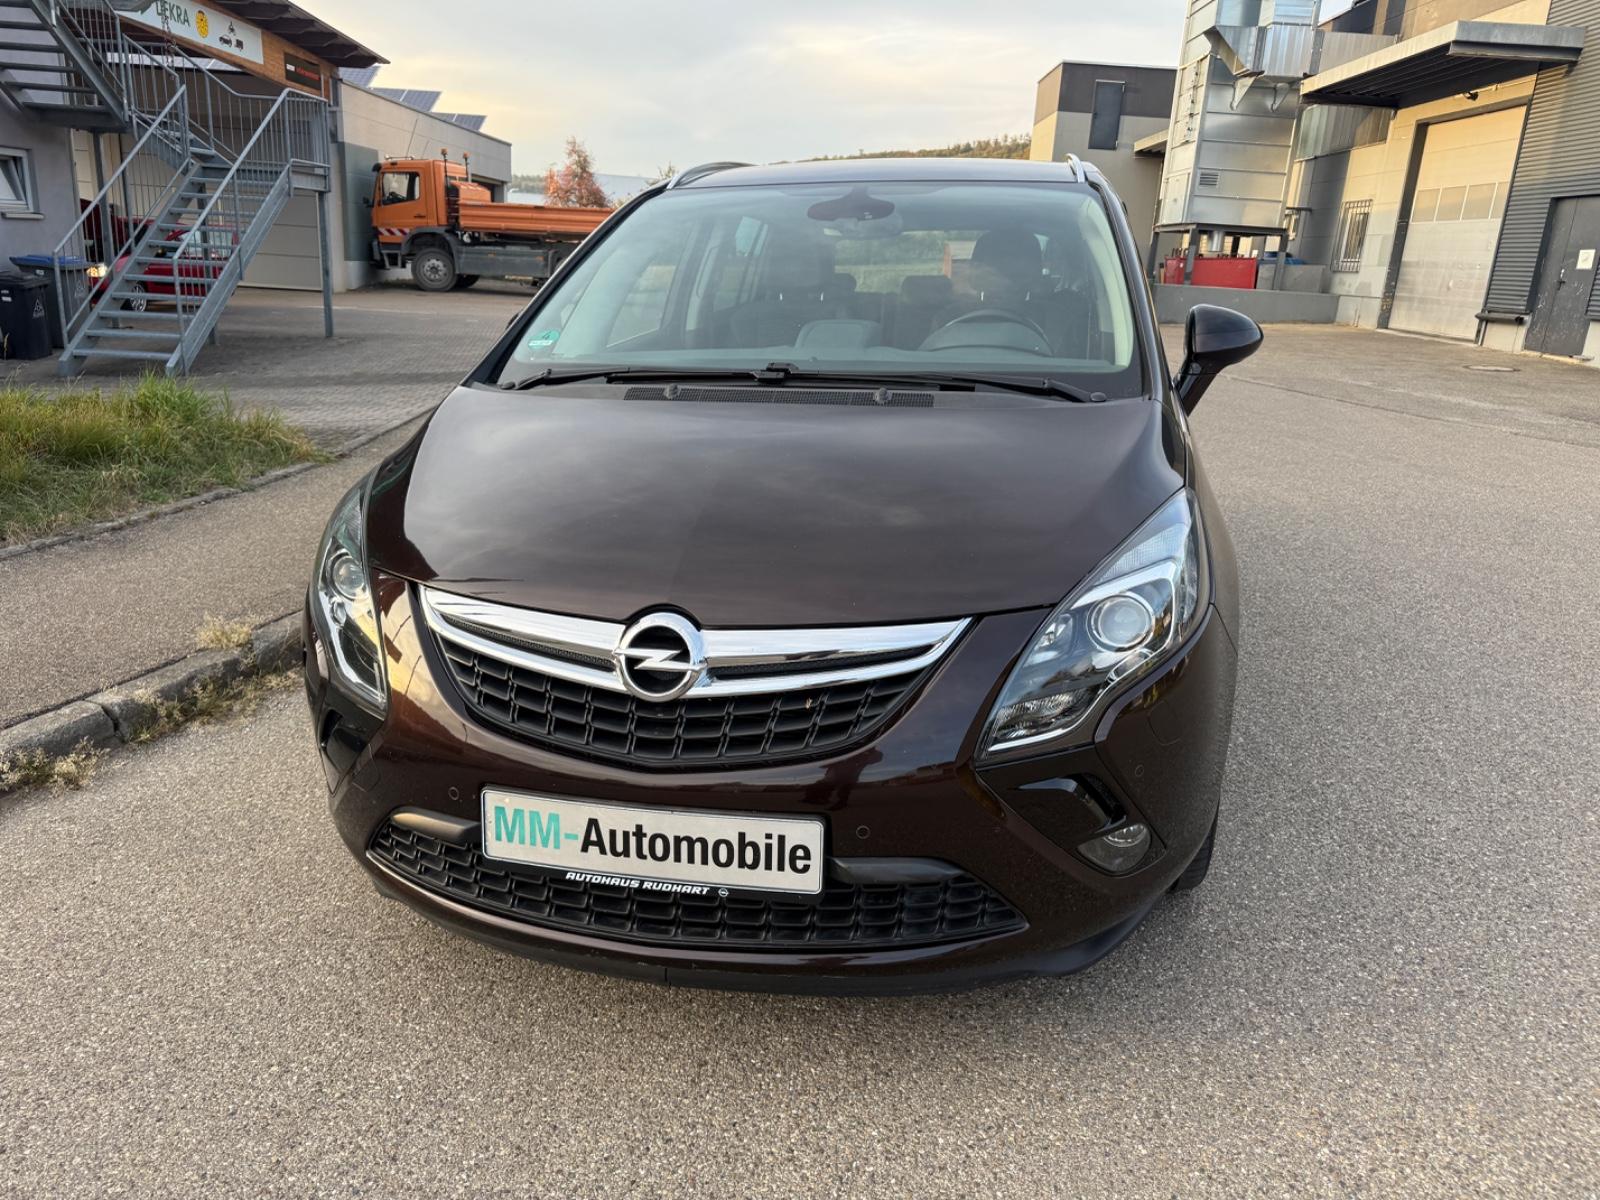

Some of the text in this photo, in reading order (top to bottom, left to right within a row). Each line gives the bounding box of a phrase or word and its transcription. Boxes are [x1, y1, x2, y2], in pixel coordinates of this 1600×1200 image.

[494, 806, 811, 874] MM-Automobile
[566, 872, 709, 895] AUTOHAUS RUDHART
